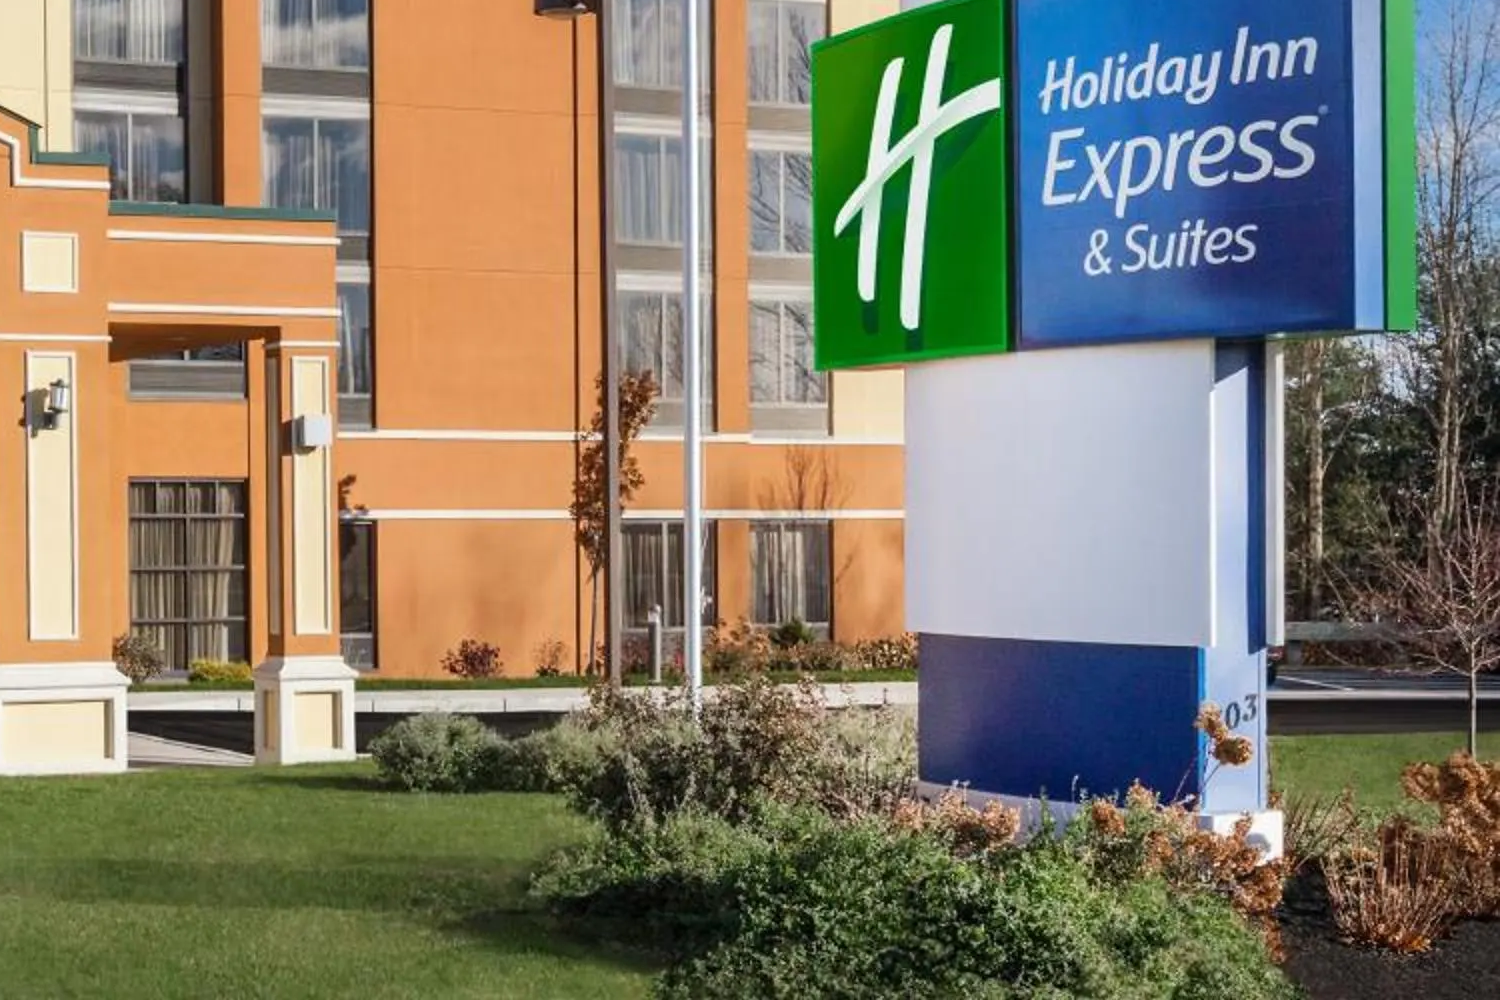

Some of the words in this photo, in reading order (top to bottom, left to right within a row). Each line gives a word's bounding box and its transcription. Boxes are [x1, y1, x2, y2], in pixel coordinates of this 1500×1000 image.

[1038, 41, 1223, 116] Holiday
[1230, 25, 1318, 85] Inn
[1042, 114, 1320, 219] Express
[1083, 228, 1112, 277] &
[1121, 218, 1259, 274] Suites
[1219, 693, 1258, 731] 03
